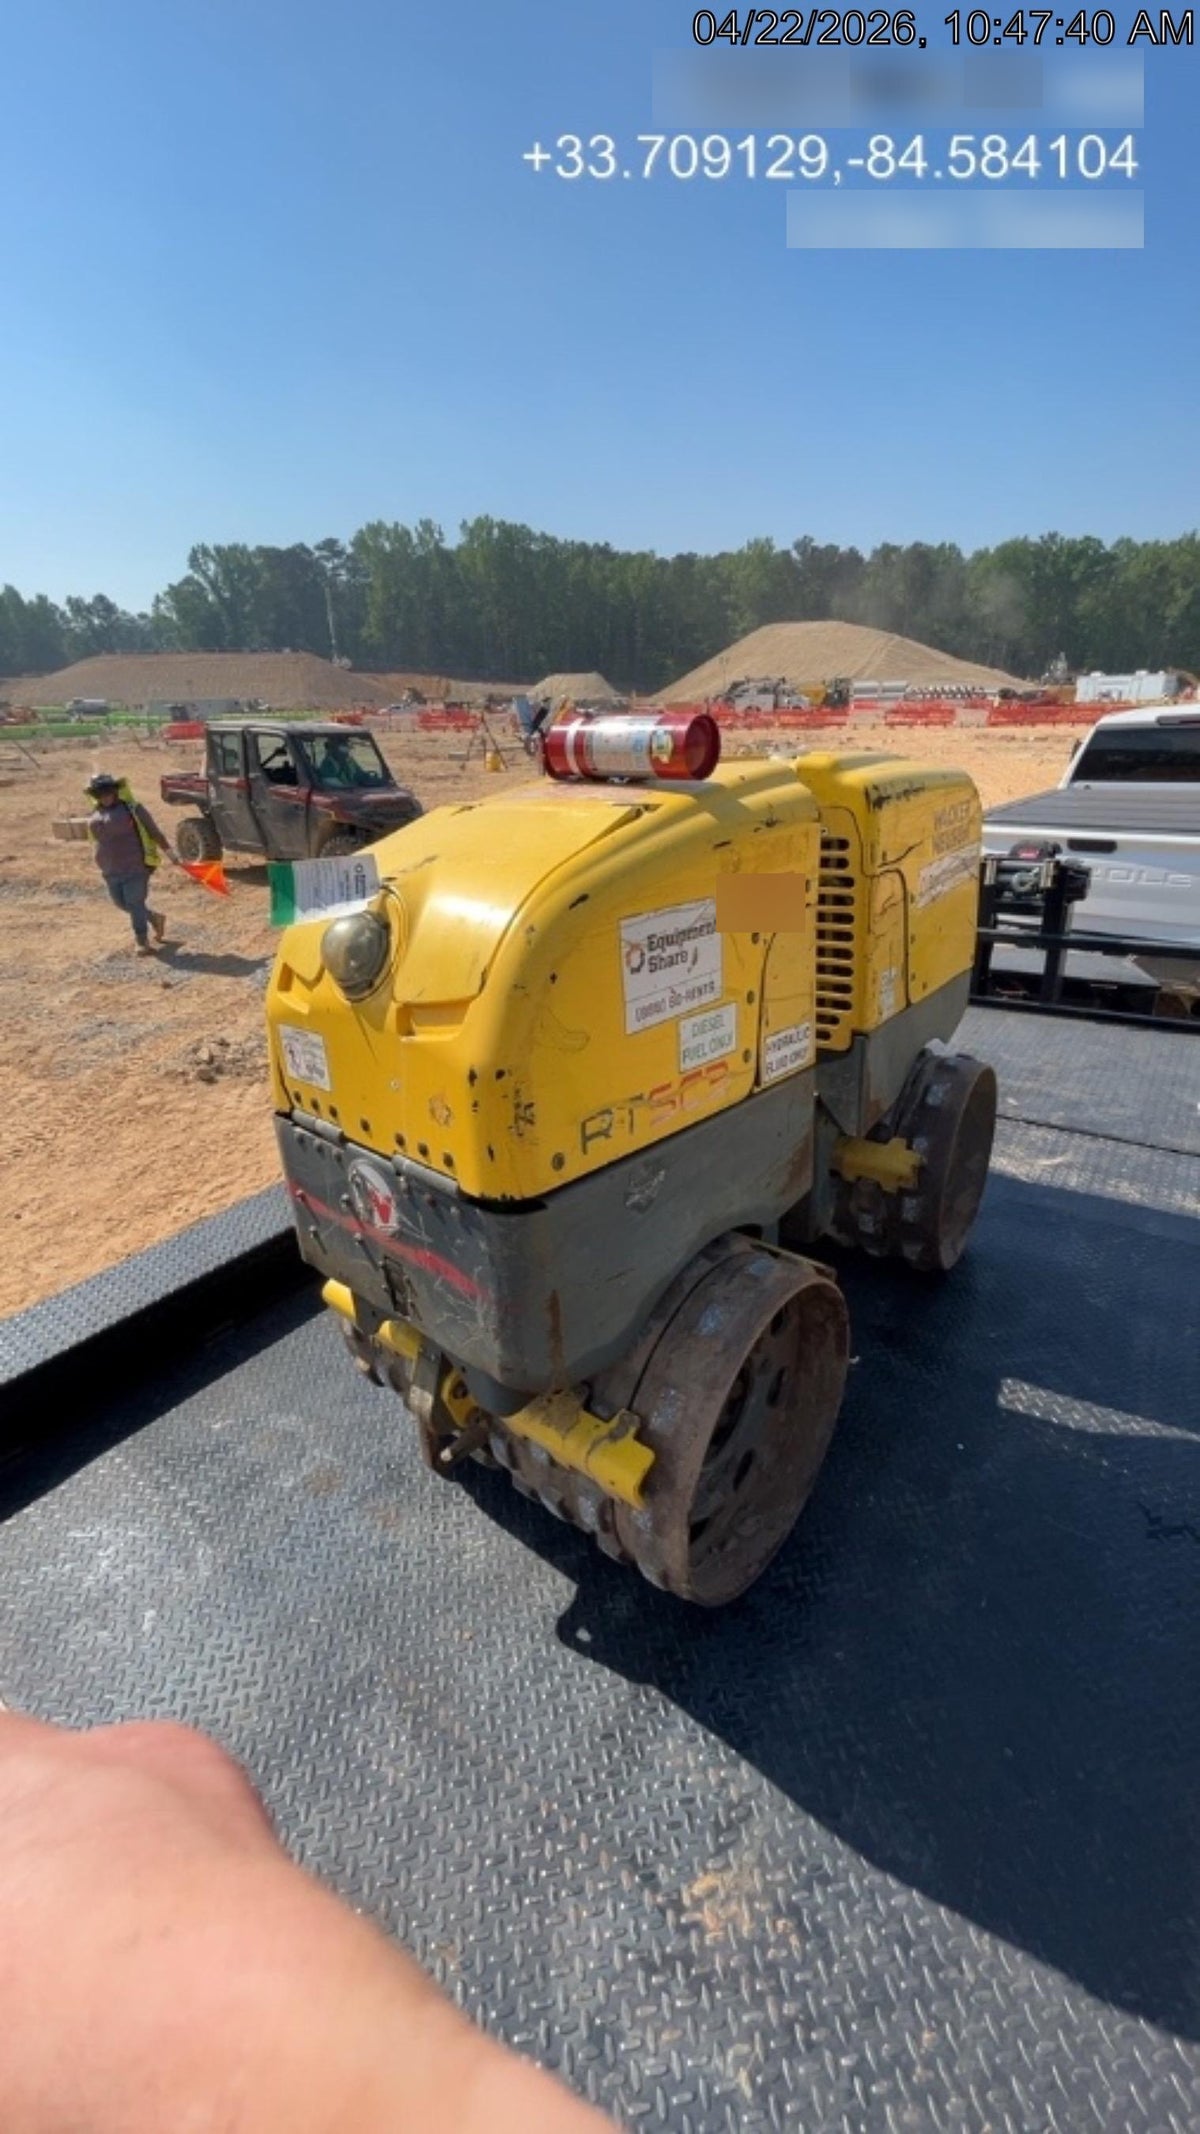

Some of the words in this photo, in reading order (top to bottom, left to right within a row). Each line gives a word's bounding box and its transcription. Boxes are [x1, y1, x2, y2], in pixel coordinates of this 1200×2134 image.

[647, 950, 689, 974] Share
[691, 1014, 726, 1038] DIESEL
[682, 1043, 708, 1065] FUEL
[708, 1033, 734, 1053] ONLY
